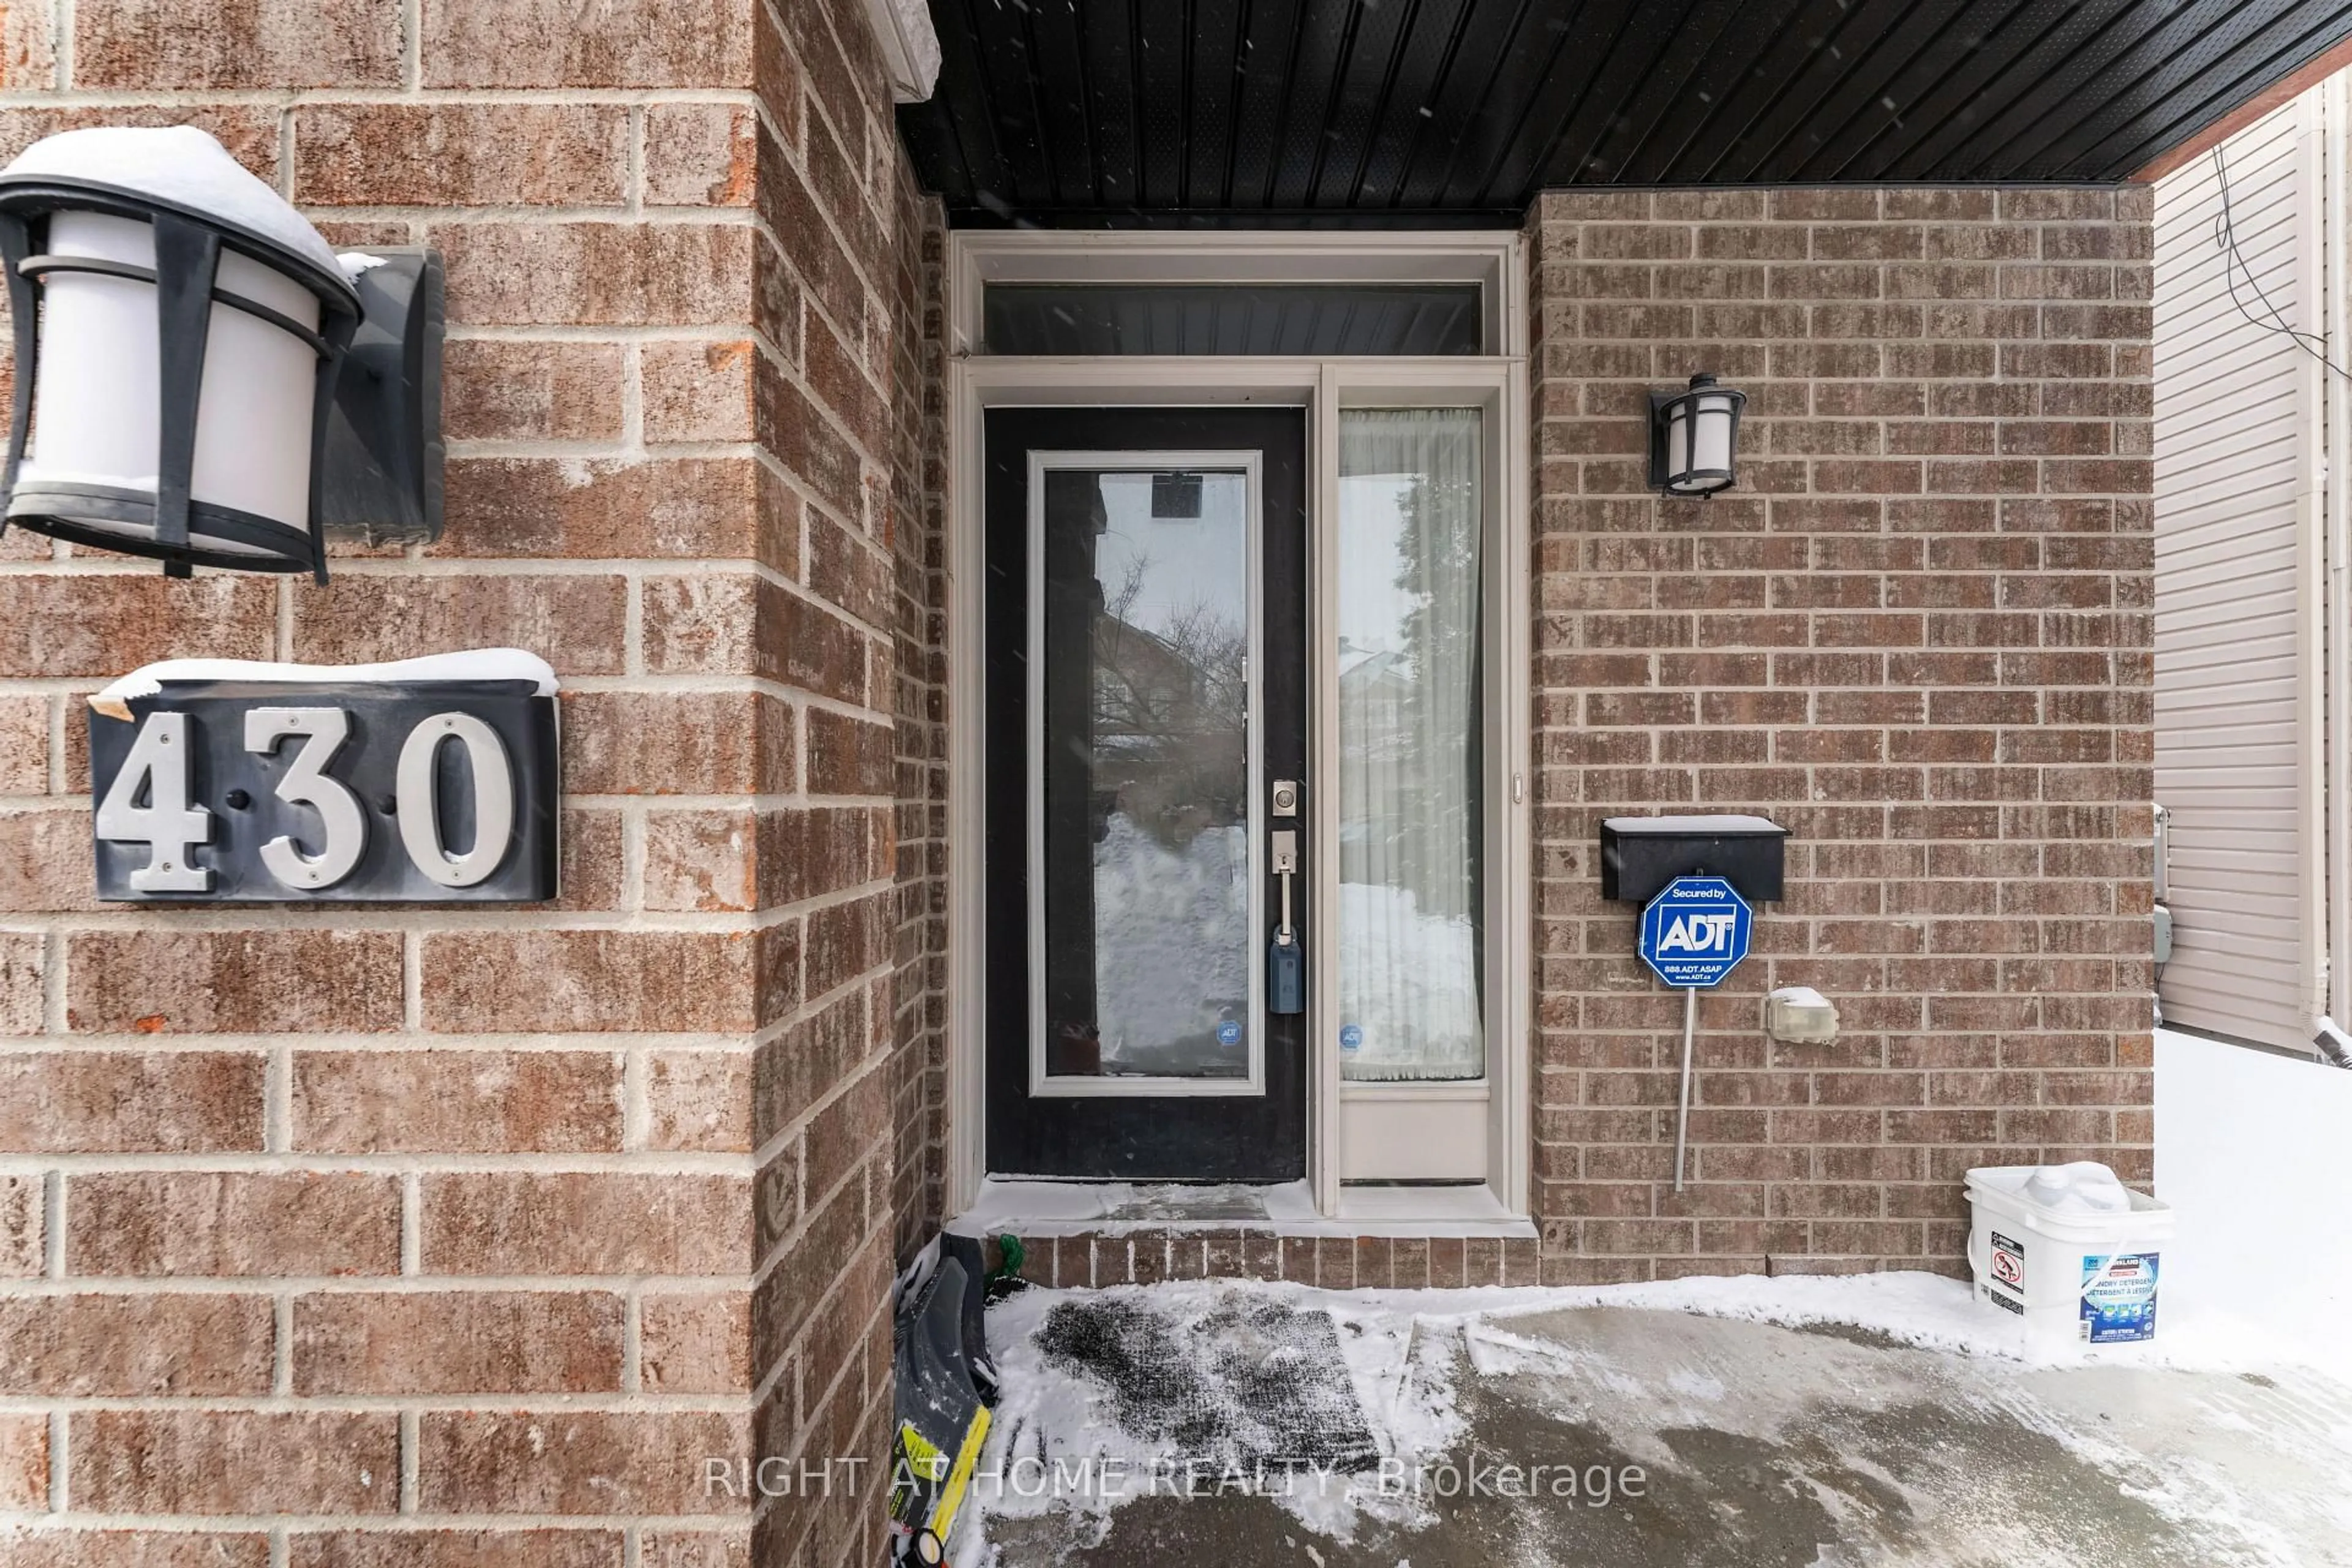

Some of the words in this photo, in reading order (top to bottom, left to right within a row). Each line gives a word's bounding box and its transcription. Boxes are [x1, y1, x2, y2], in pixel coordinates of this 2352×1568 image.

[97, 707, 517, 892] 430
[1673, 889, 1713, 898] Secured
[1714, 889, 1727, 899] by
[1659, 914, 1735, 951] ADT
